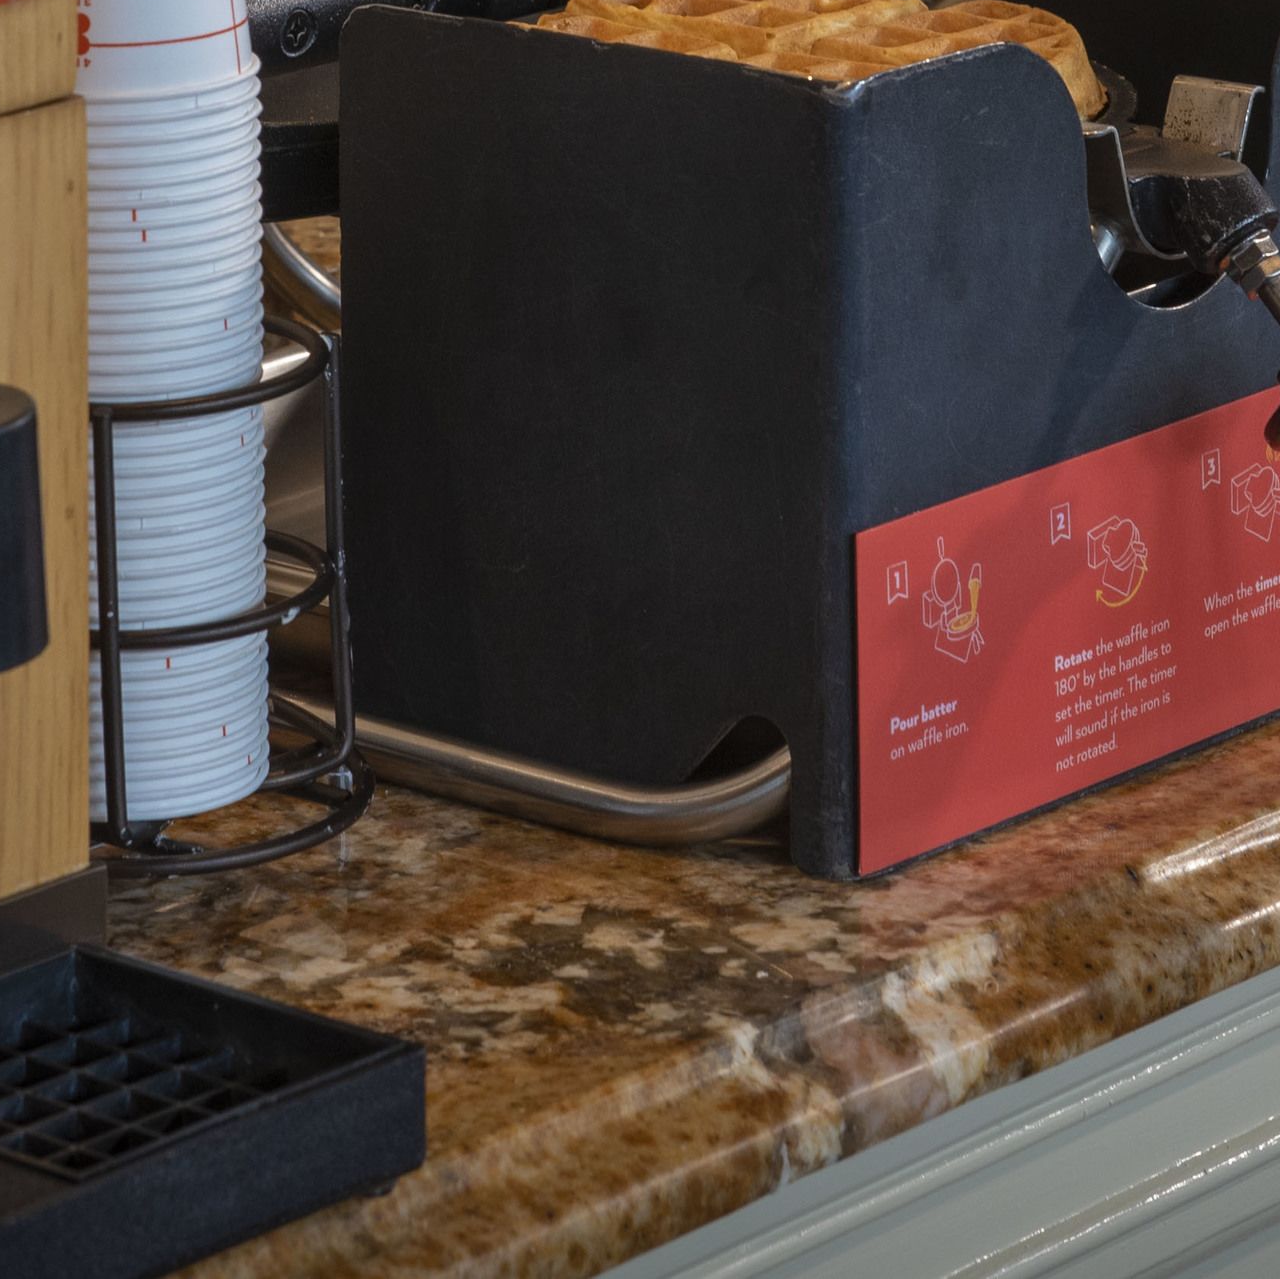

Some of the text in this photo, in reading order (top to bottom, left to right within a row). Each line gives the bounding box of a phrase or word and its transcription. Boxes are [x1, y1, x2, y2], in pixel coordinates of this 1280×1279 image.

[1207, 458, 1216, 475] 3
[1057, 512, 1065, 530] 2
[894, 571, 900, 589] 1
[1203, 593, 1234, 612] When
[1236, 581, 1253, 600] the
[1204, 619, 1230, 639] open
[1232, 608, 1249, 627] the
[1054, 618, 1171, 673] Rotate the waffle iron
[1055, 641, 1172, 697] 180° by the handles to
[1055, 664, 1177, 723] set the timer. The timer
[890, 699, 958, 735] Pour batter
[1055, 690, 1171, 748] will sound if the iron is
[890, 720, 969, 761] on waffle iron.
[1056, 732, 1118, 773] not rotated.
